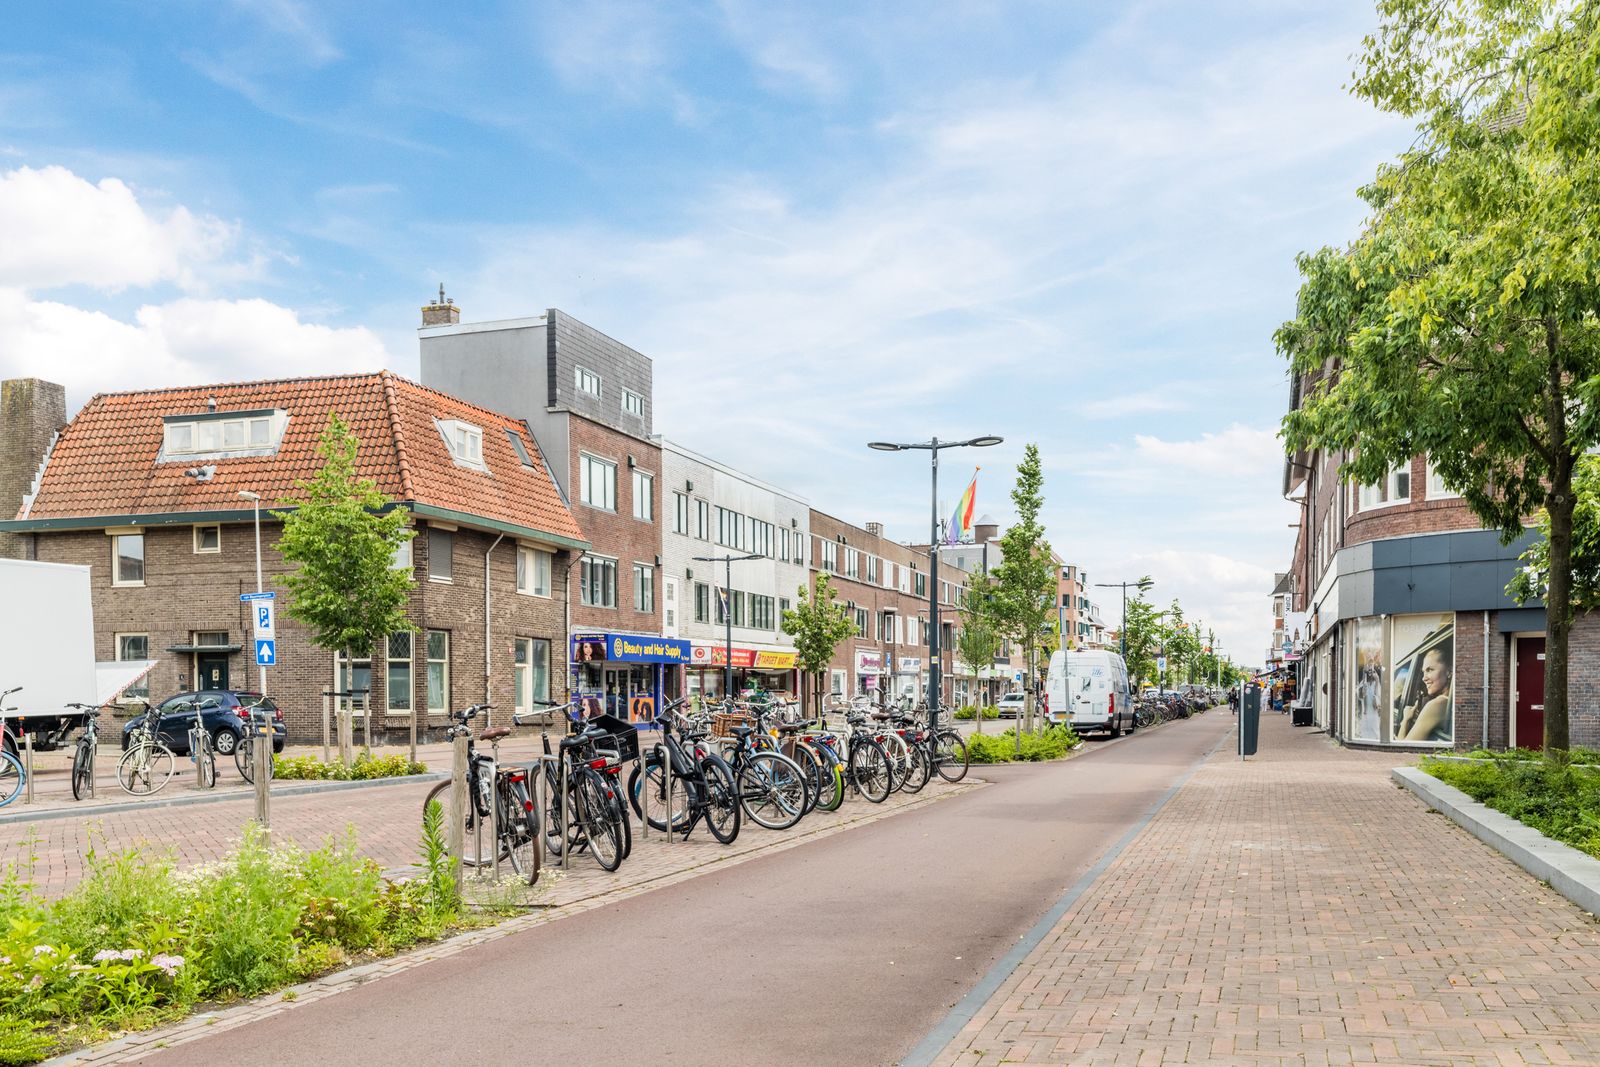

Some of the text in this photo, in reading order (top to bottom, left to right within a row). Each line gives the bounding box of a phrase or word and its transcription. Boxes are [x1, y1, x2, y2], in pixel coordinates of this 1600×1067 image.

[261, 609, 267, 619] P
[624, 641, 681, 658] Beauty and Hair Supply
